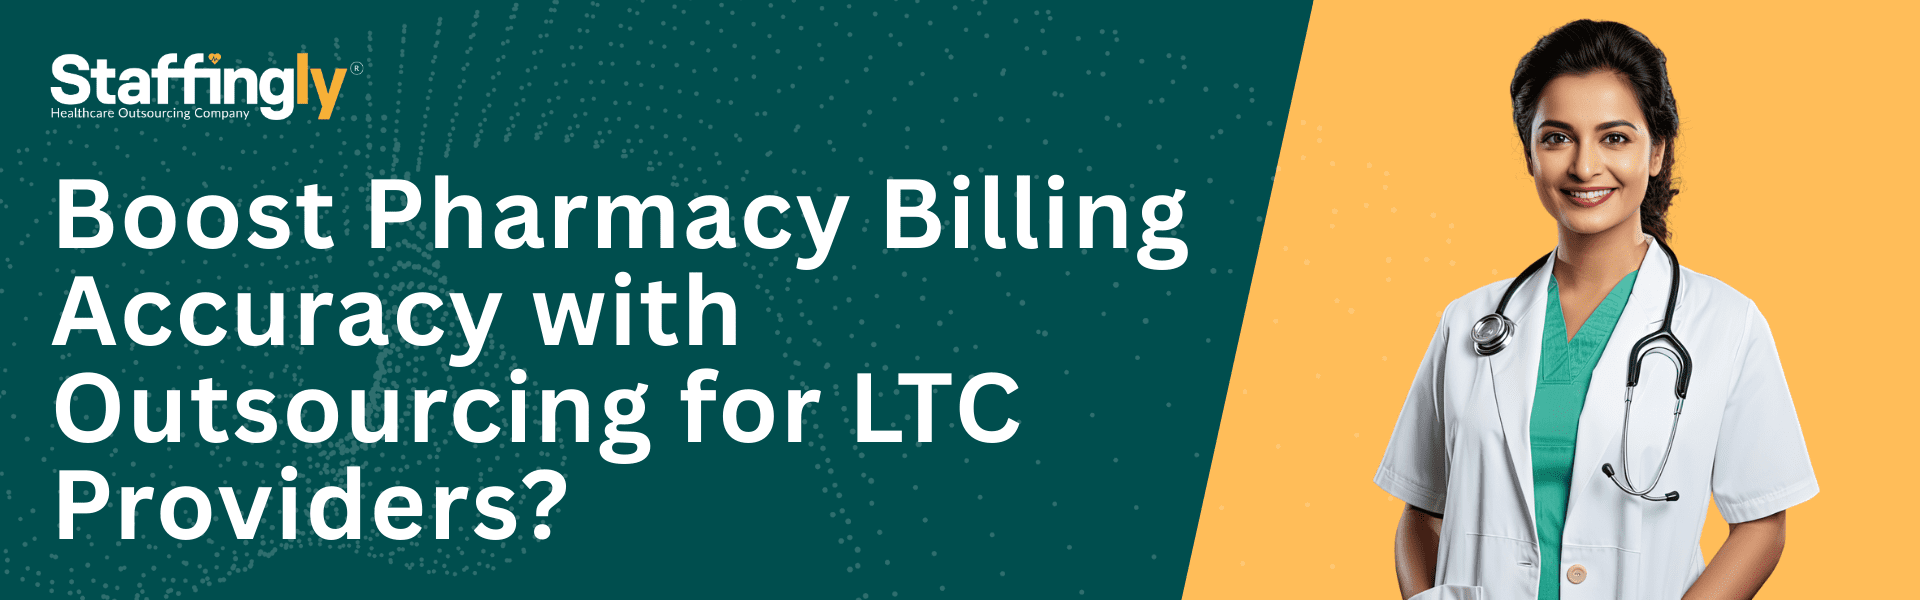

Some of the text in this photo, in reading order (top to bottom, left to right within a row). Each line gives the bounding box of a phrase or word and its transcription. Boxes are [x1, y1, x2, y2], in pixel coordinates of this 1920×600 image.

[51, 52, 348, 120] Staffingly
[51, 107, 250, 120] Healthcare Outsourcing Company
[58, 174, 1189, 271] Boost Pharmacy Billing
[51, 271, 737, 368] Accuracy with
[55, 367, 1020, 465] Outsourcing for LTC
[58, 465, 567, 541] Providers?
